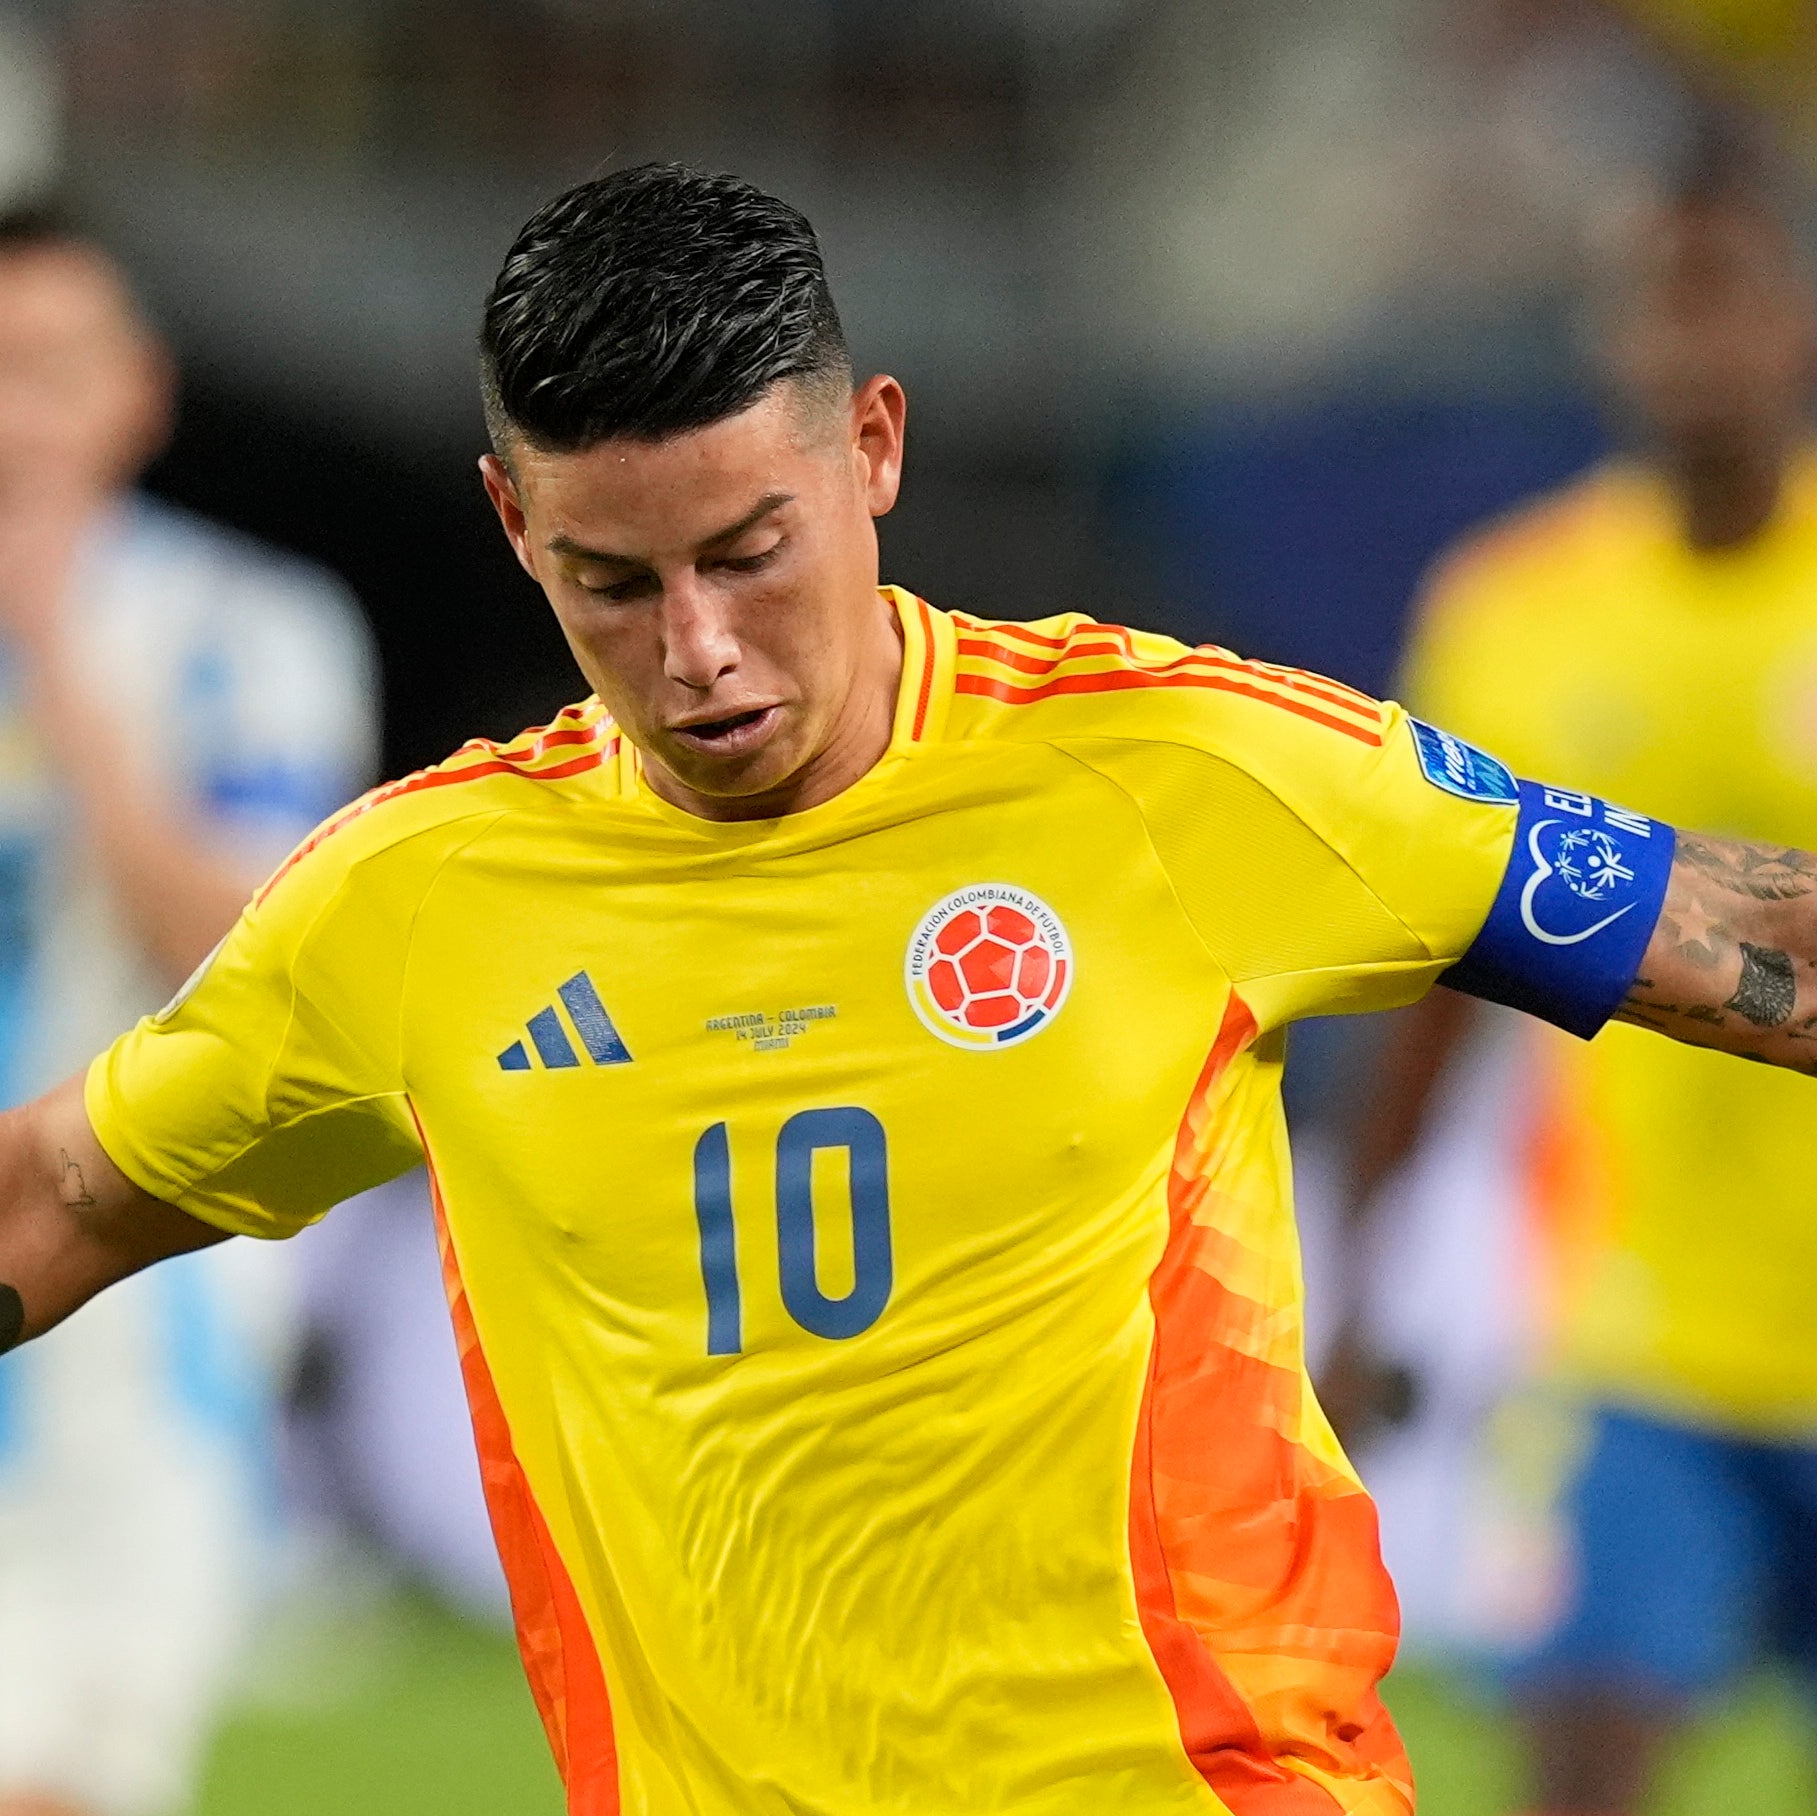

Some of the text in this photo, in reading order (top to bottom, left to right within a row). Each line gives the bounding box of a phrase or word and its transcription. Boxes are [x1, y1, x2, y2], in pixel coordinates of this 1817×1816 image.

[948, 889, 1023, 912] COLOMBIANA
[1024, 901, 1040, 916] DE
[778, 1023, 806, 1036] 2024
[693, 1105, 894, 1357] 10
